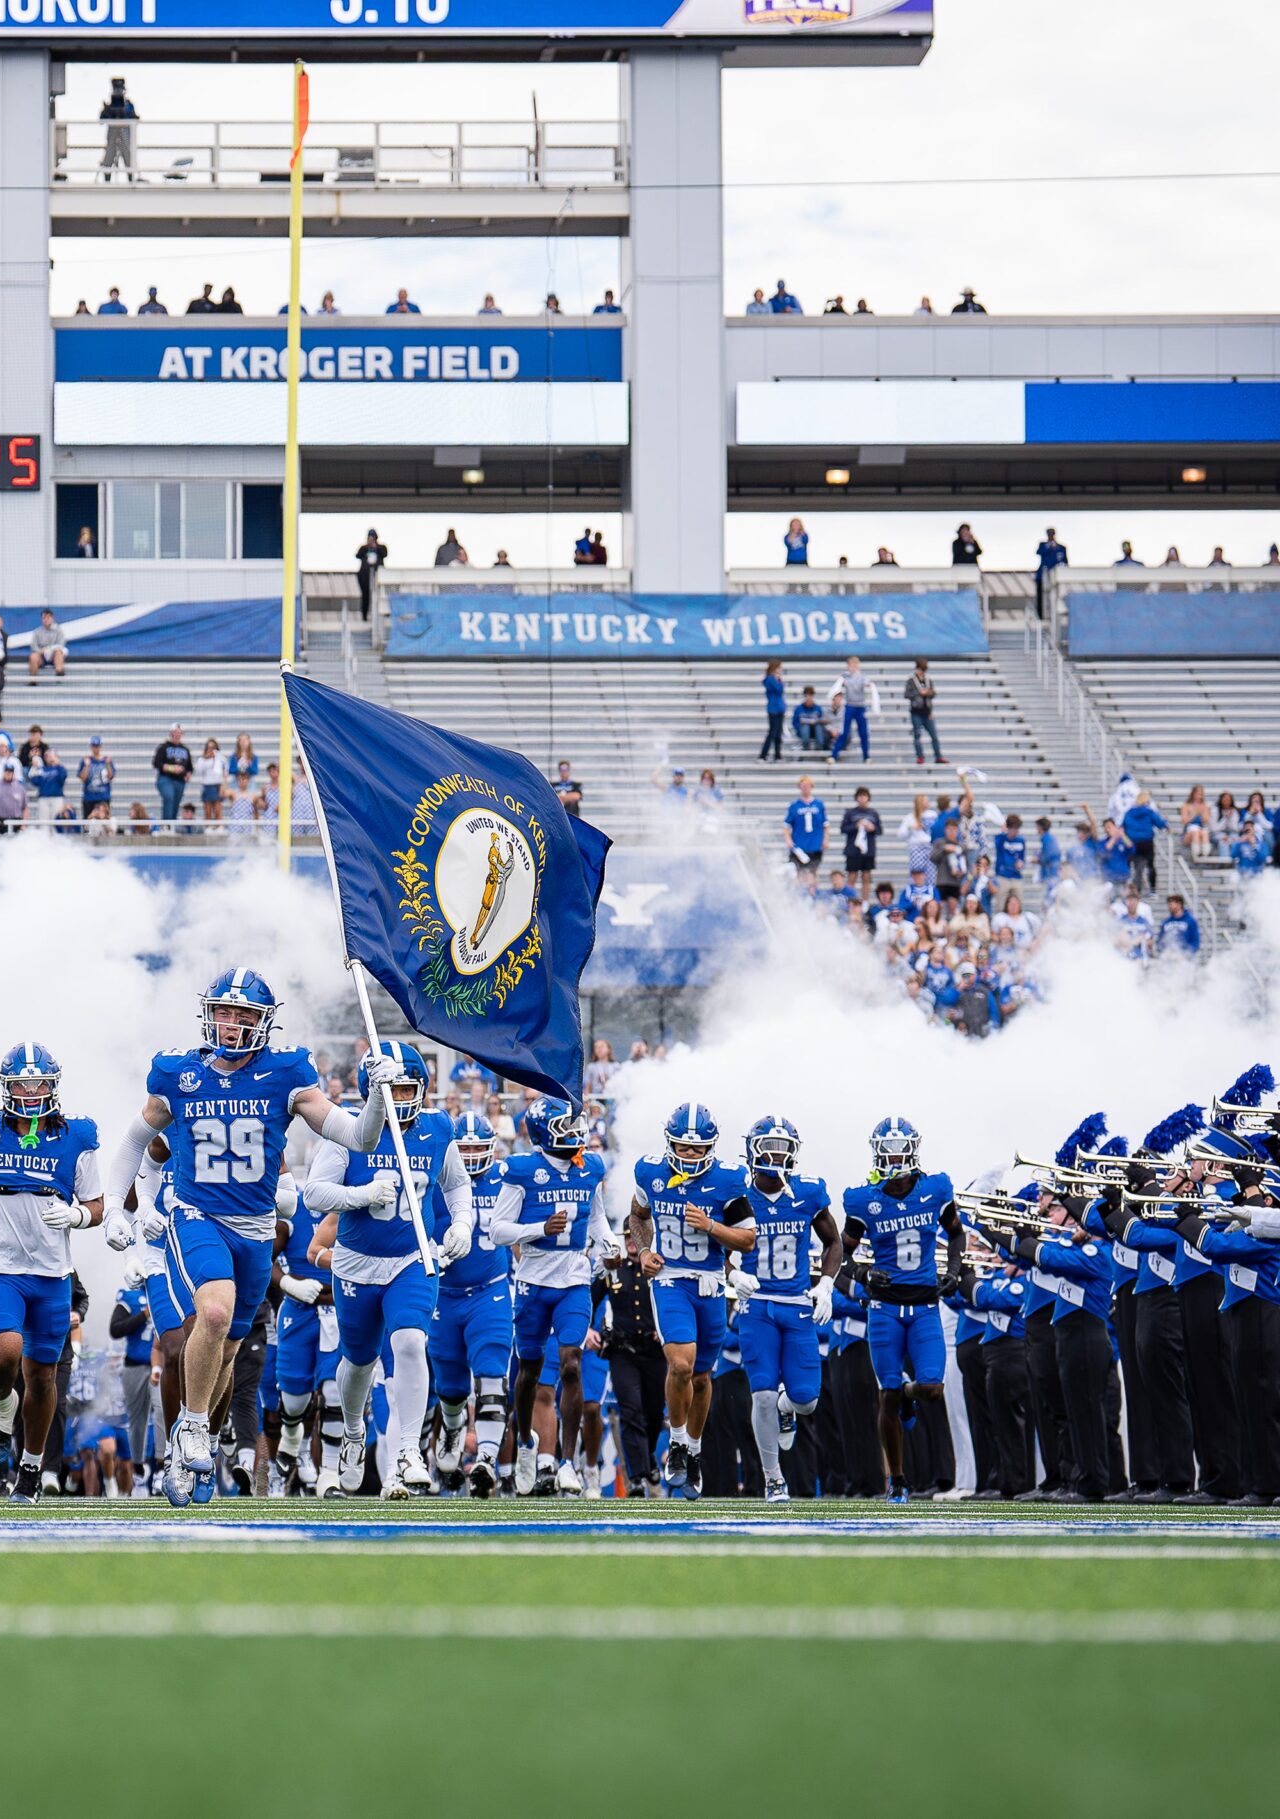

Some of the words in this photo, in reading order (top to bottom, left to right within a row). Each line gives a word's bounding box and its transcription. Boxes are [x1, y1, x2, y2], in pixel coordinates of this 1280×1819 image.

[158, 346, 212, 379] AT
[221, 346, 394, 380] KROGER
[402, 347, 520, 379] FIELD
[460, 611, 679, 649] KENTUCKY
[701, 611, 908, 647] WILDCATS
[407, 773, 500, 847] COMMONWEALTH
[503, 794, 525, 816] OF
[465, 816, 494, 834] UNITED
[495, 820, 510, 838] WE
[510, 833, 531, 872] STAND
[472, 949, 488, 965] FALL
[185, 1099, 270, 1118] KENTUCKY
[191, 1117, 266, 1184] 29
[367, 1154, 433, 1170] KENTCKY
[537, 1190, 591, 1203] KENTUCKY
[654, 1200, 714, 1218] KENTUKY
[755, 1220, 806, 1235] ENTUCKY
[875, 1211, 934, 1234] KENTUCKY
[756, 1234, 798, 1280] 18
[895, 1228, 922, 1271] 6
